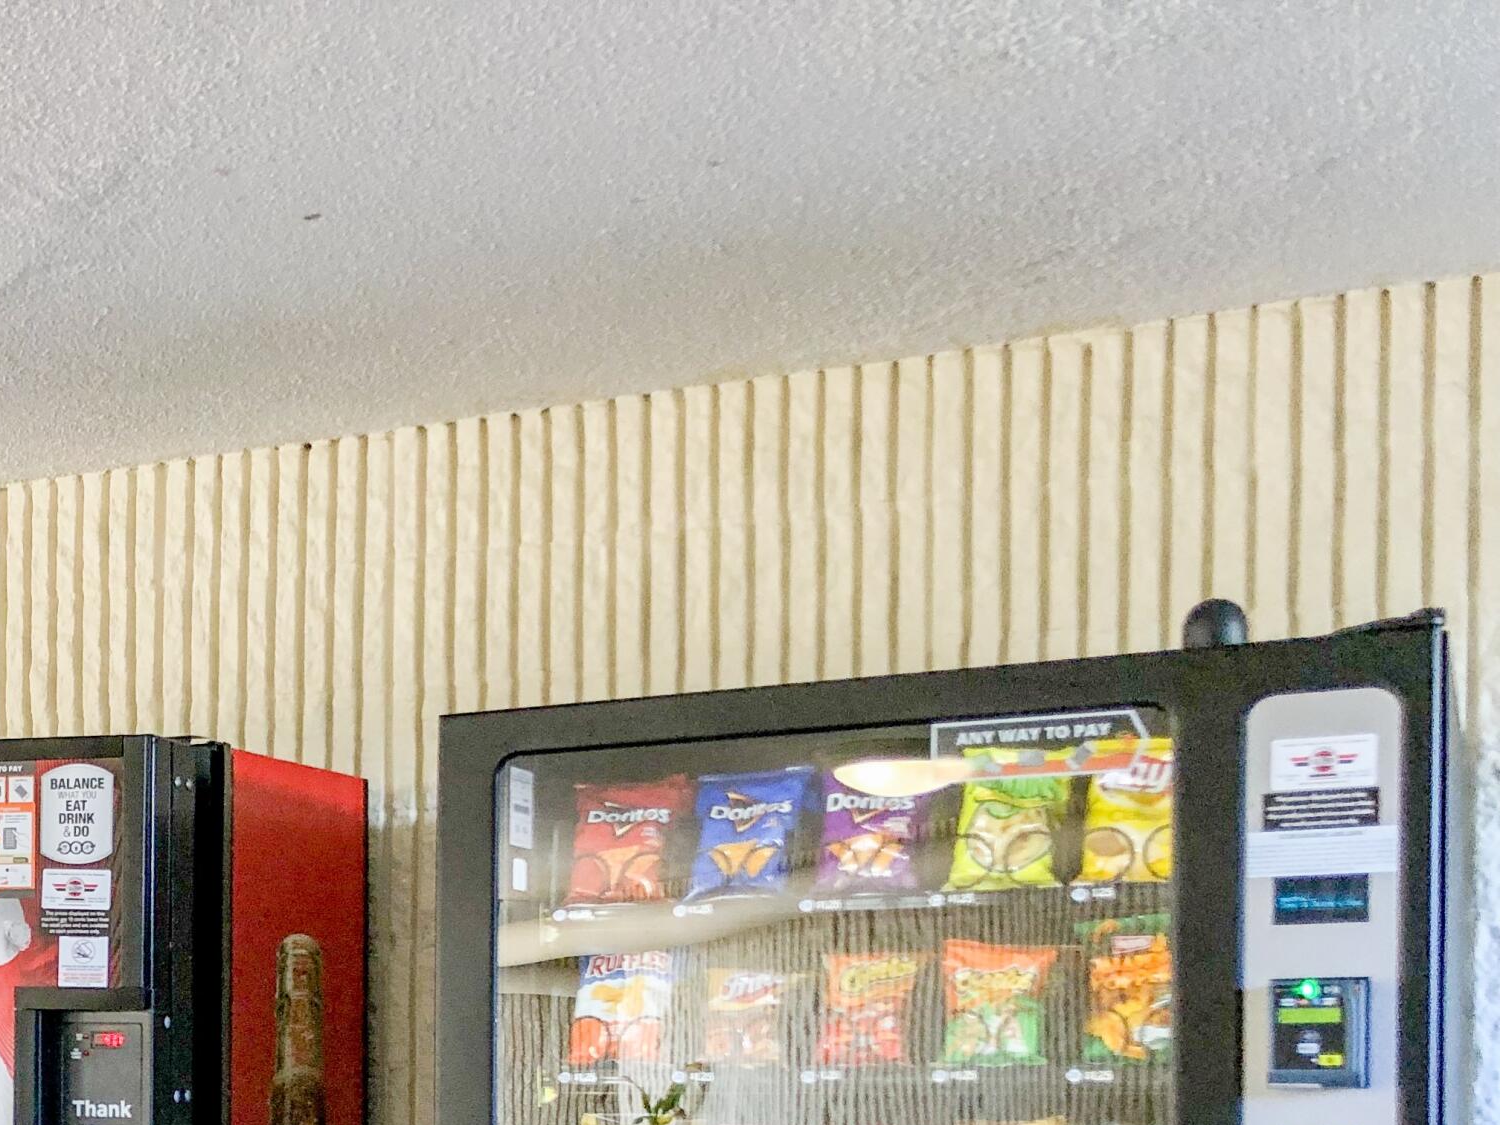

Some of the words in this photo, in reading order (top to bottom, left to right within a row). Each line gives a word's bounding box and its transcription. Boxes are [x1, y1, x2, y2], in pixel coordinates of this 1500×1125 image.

[956, 731, 995, 746] ANY
[998, 728, 1041, 743] WAY
[1044, 726, 1070, 739] TO
[1073, 723, 1112, 737] PAY
[50, 777, 105, 790] BALANCE
[58, 791, 80, 799] WHAT
[81, 791, 97, 799] YOU
[826, 793, 915, 812] Doritos
[65, 800, 87, 811] EAT
[710, 800, 793, 821] Doritos
[58, 813, 95, 824] DRINK
[588, 808, 671, 824] Doritos
[63, 826, 70, 836] &
[73, 826, 89, 837] DO
[587, 952, 672, 979] RUFFLES
[72, 1099, 132, 1118] Thank
